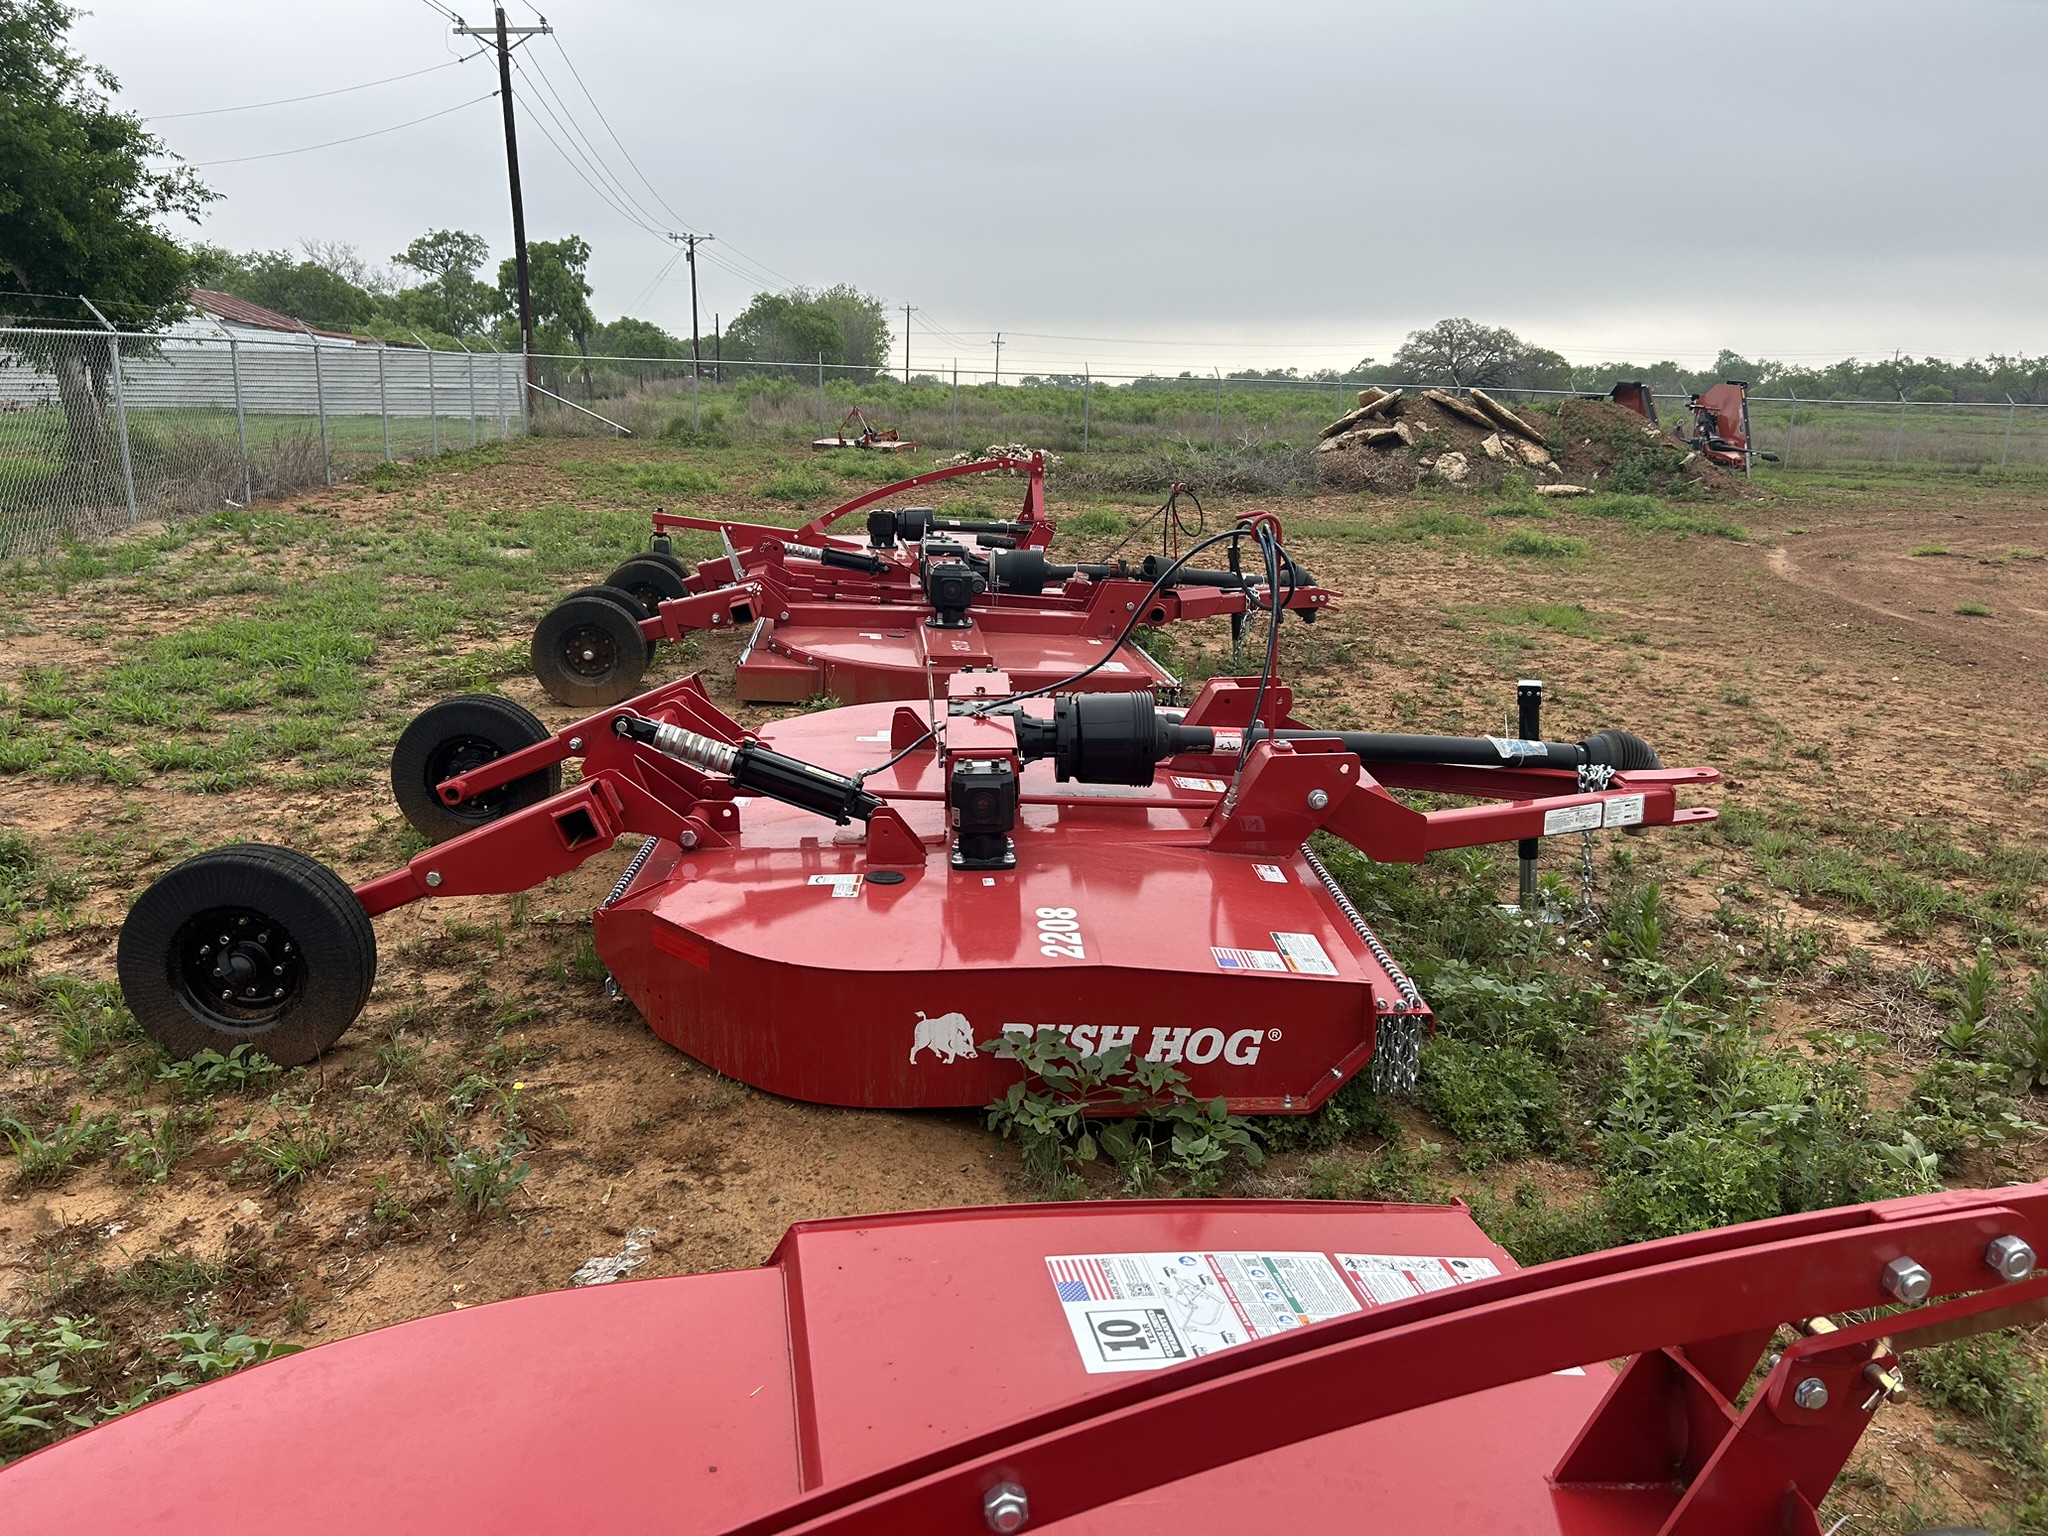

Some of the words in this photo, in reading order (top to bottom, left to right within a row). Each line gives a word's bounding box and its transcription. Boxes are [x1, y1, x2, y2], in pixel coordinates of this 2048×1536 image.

[1036, 907, 1085, 959] 2208
[1233, 1302, 1249, 1321] DANGER
[1097, 1319, 1149, 1351] 10
[1142, 1323, 1156, 1344] YEAR
